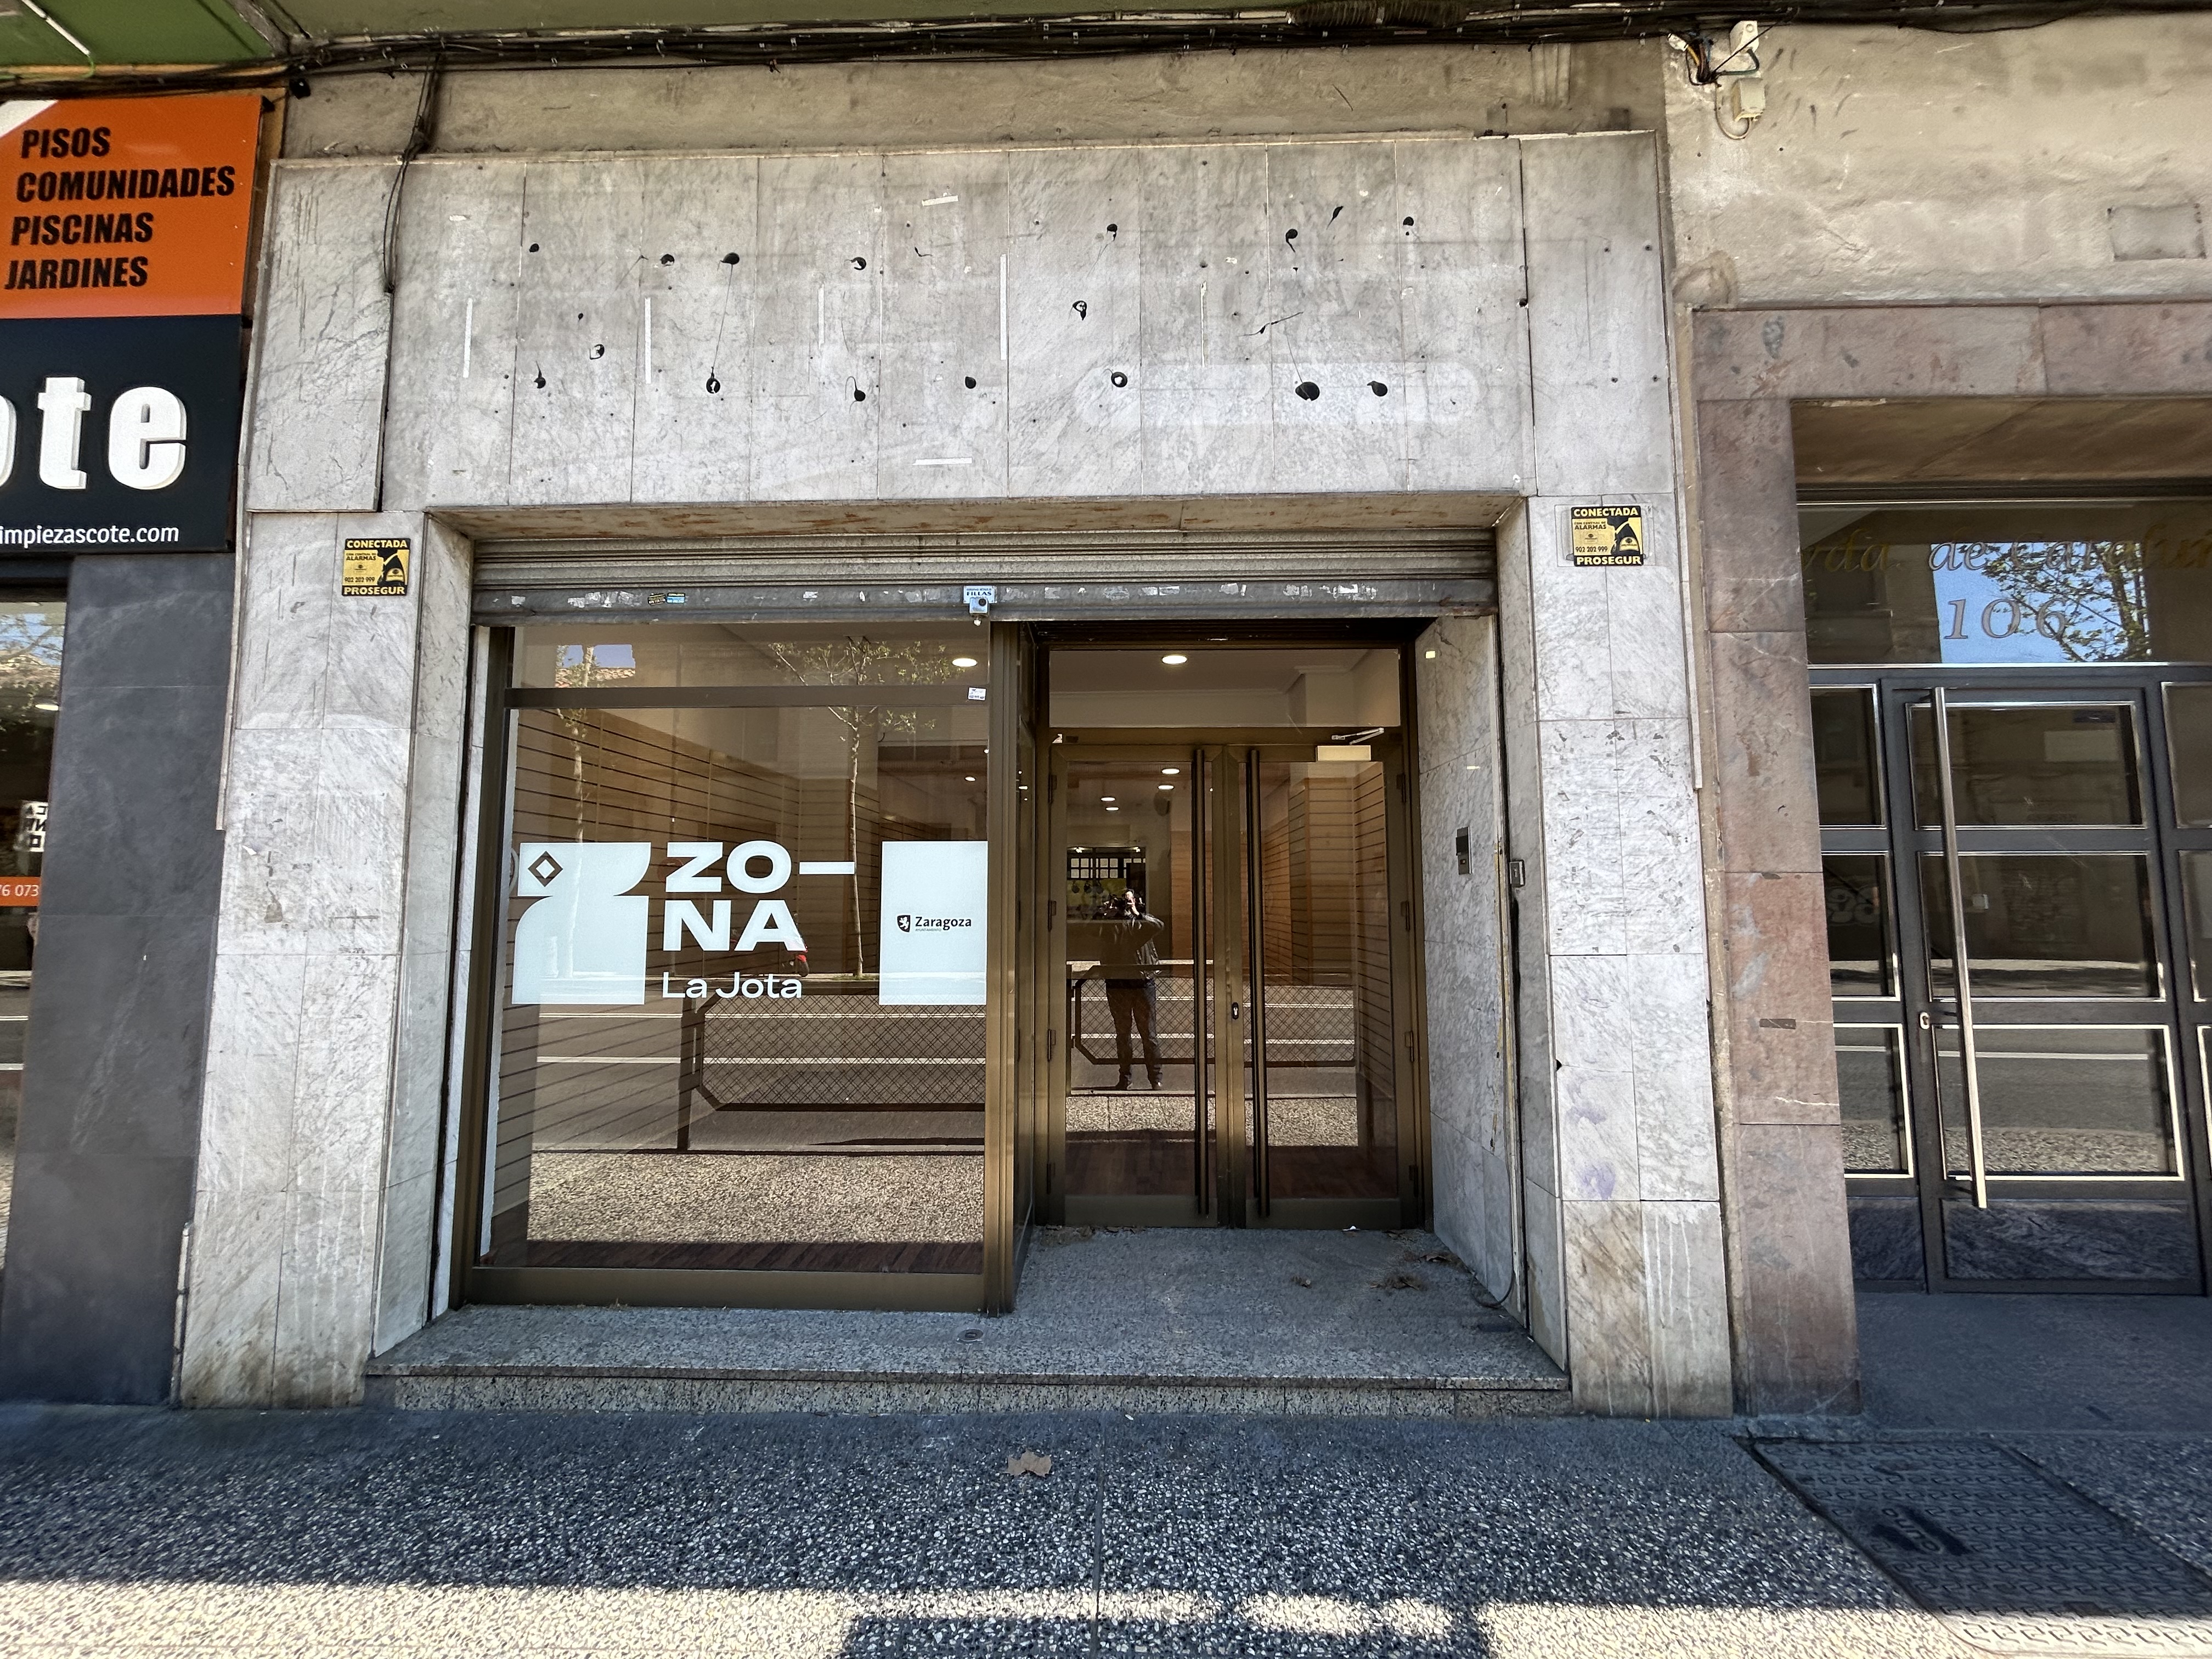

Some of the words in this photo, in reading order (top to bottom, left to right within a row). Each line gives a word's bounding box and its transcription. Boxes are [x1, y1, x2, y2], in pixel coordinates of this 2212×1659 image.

[20, 127, 111, 158] PISOS
[16, 166, 235, 202] COMUNIDADES
[10, 212, 154, 245] PISCINAS
[4, 256, 149, 290] JARDINES
[0, 377, 187, 490] te
[1573, 507, 1639, 517] CONECTADA
[347, 540, 408, 548] CONECTADA
[1577, 556, 1641, 565] PROSEGUR
[1944, 599, 2069, 639] 106
[15, 884, 39, 896] 073
[663, 900, 807, 951] NA
[915, 917, 972, 930] Zaragoza
[662, 972, 707, 998] La
[715, 972, 803, 998] Jota
